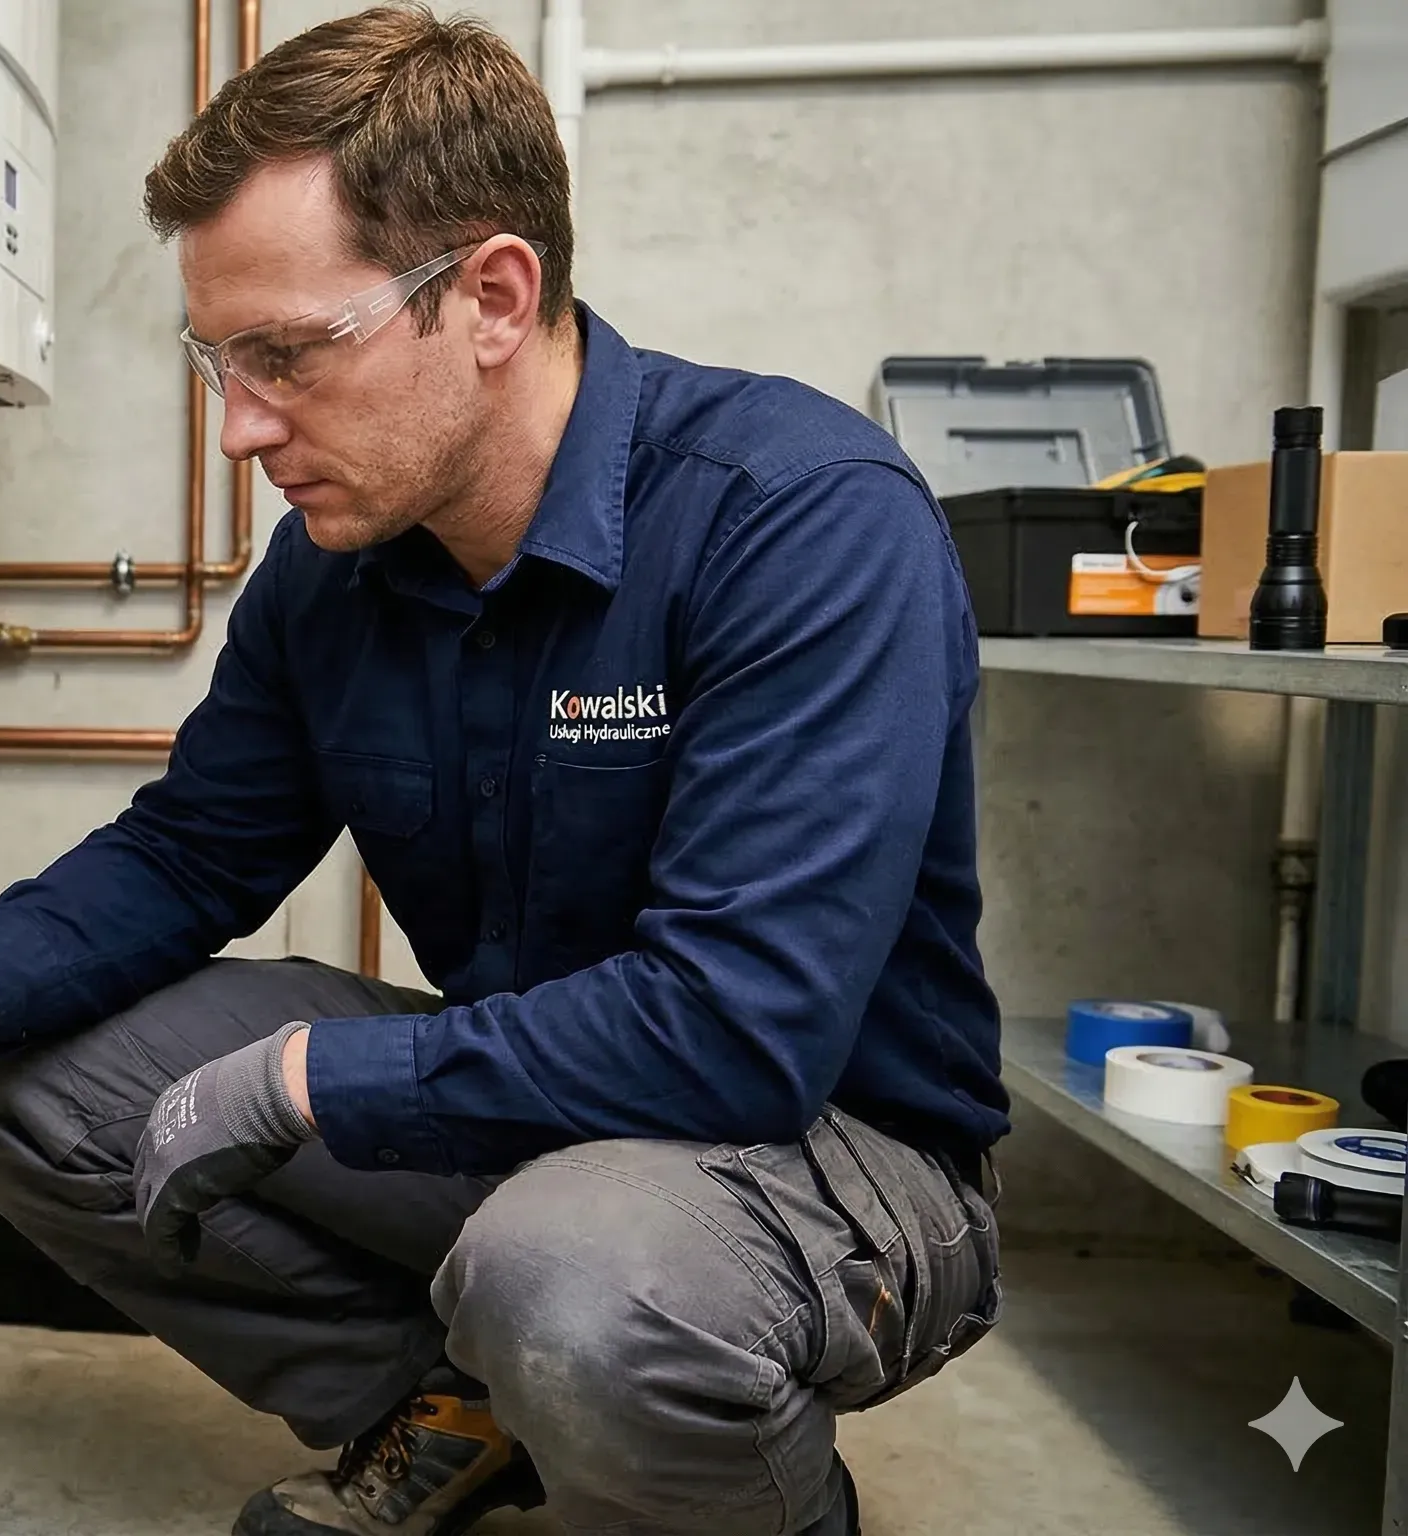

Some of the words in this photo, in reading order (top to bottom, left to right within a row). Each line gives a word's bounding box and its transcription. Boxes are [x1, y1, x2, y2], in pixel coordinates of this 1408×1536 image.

[550, 684, 667, 720] Kowalski
[549, 723, 581, 744] Usługi
[584, 723, 671, 745] Hydrauliczne
